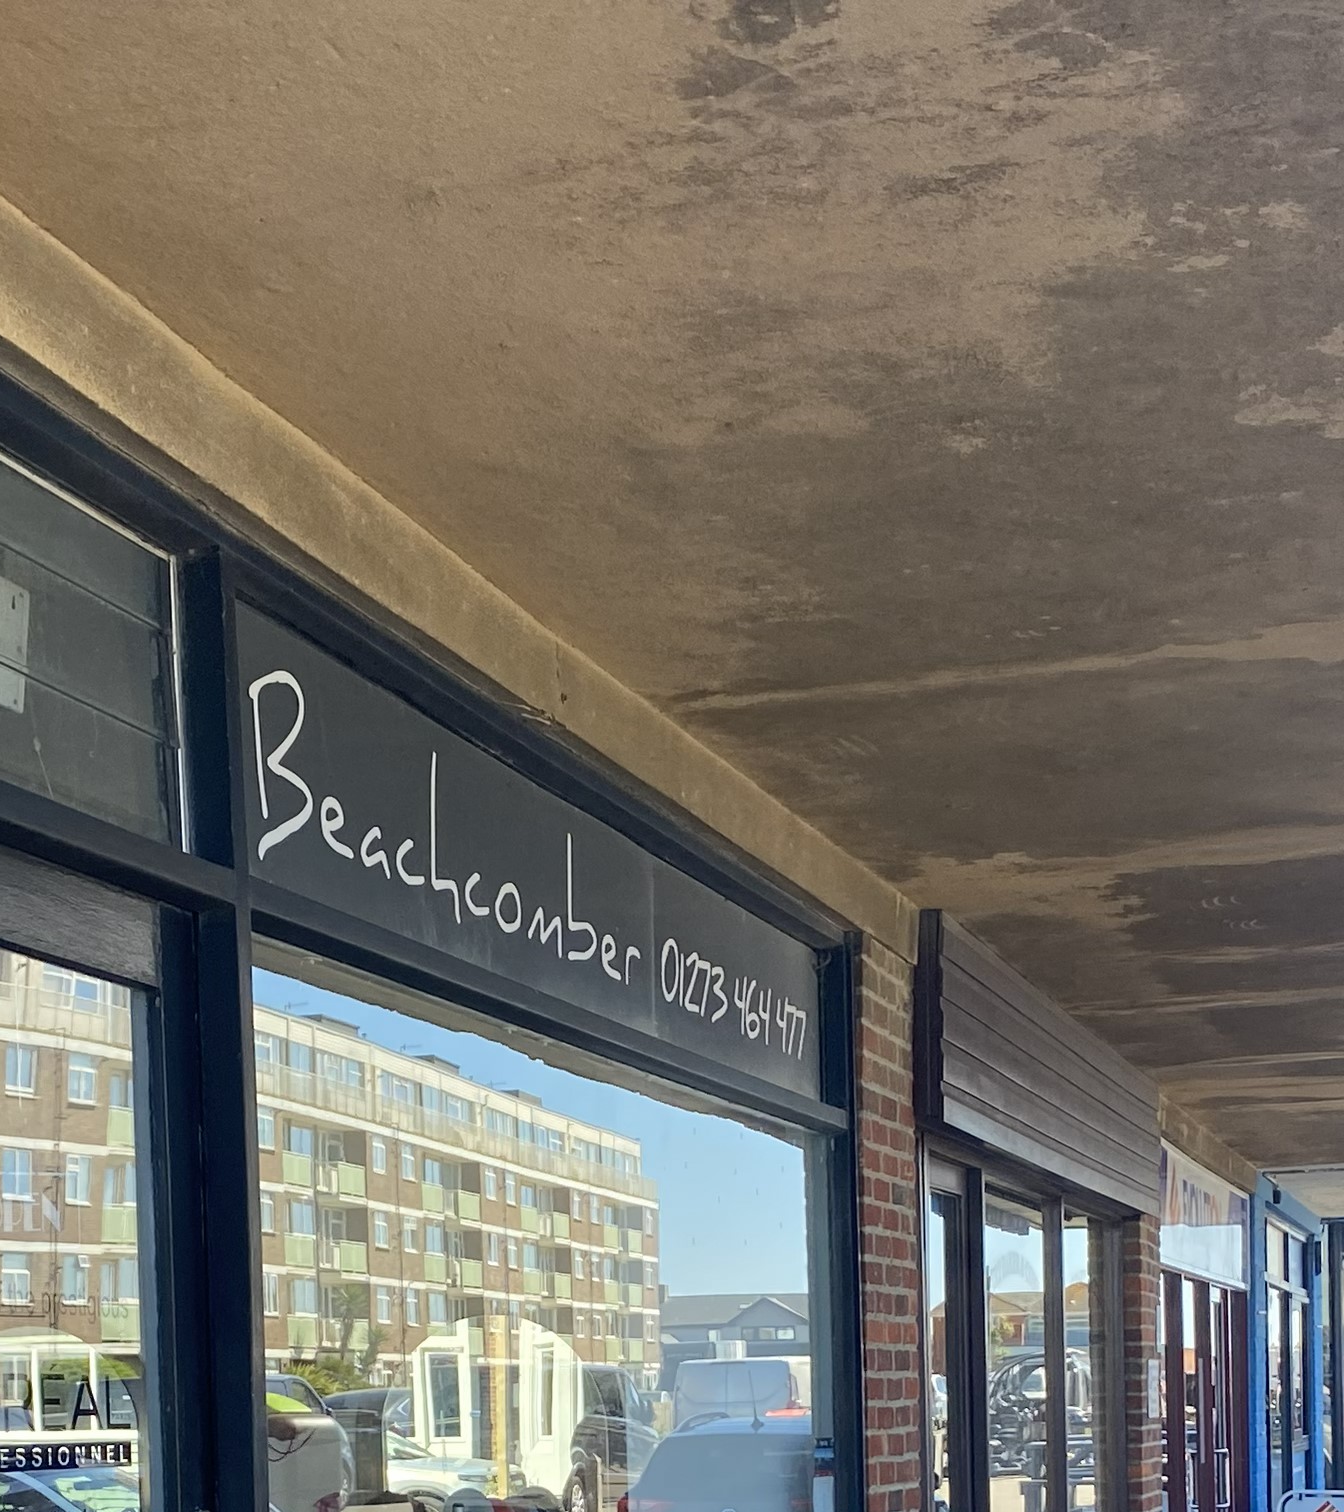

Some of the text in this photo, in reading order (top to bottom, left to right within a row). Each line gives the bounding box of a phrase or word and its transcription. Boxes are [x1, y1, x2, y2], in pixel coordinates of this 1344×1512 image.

[247, 669, 806, 1061] Beachcomber 01273 464 477
[7, 1281, 36, 1315] the
[42, 1286, 130, 1325] prestigious
